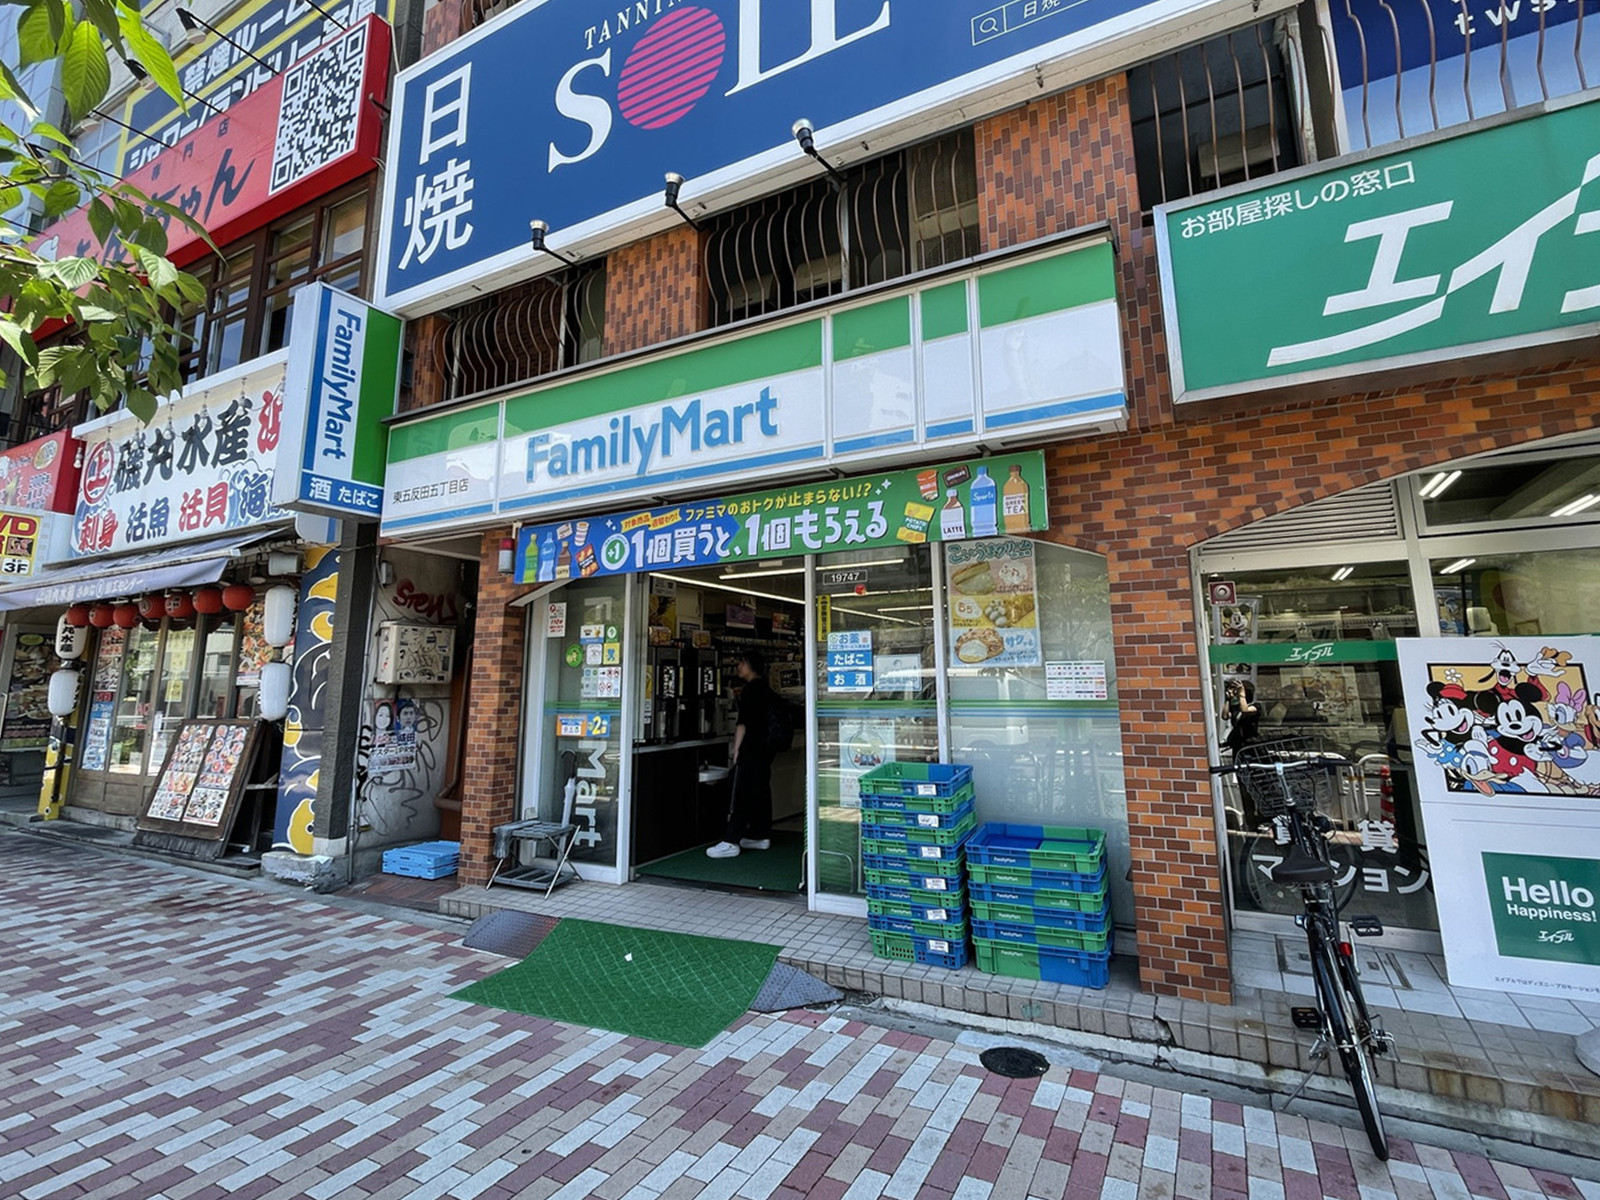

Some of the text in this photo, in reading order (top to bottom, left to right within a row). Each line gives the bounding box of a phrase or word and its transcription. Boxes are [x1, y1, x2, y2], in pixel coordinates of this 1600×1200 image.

[584, 0, 682, 50] TANNI
[398, 62, 474, 270] 日焼
[1181, 161, 1415, 238] お部屋探しの窓口
[322, 308, 362, 460] FamilyMart
[114, 398, 254, 494] 磯丸水産
[525, 385, 778, 484] FamilyMart
[309, 476, 379, 509] 酒 たばこ
[393, 478, 469, 504] 東五反田五丁目店
[78, 472, 281, 551] 刺身 活魚 活貝 海
[1006, 505, 1026, 514] TEA
[943, 526, 963, 534] LATTE
[4, 563, 28, 574] 3F
[831, 572, 860, 583] 19747
[60, 617, 75, 652] 丸水産
[834, 653, 865, 665] たばこ
[1285, 642, 1334, 662] エイブル
[1252, 854, 1429, 894] マション
[1502, 876, 1594, 907] Hello
[1506, 903, 1597, 922] Happiness!
